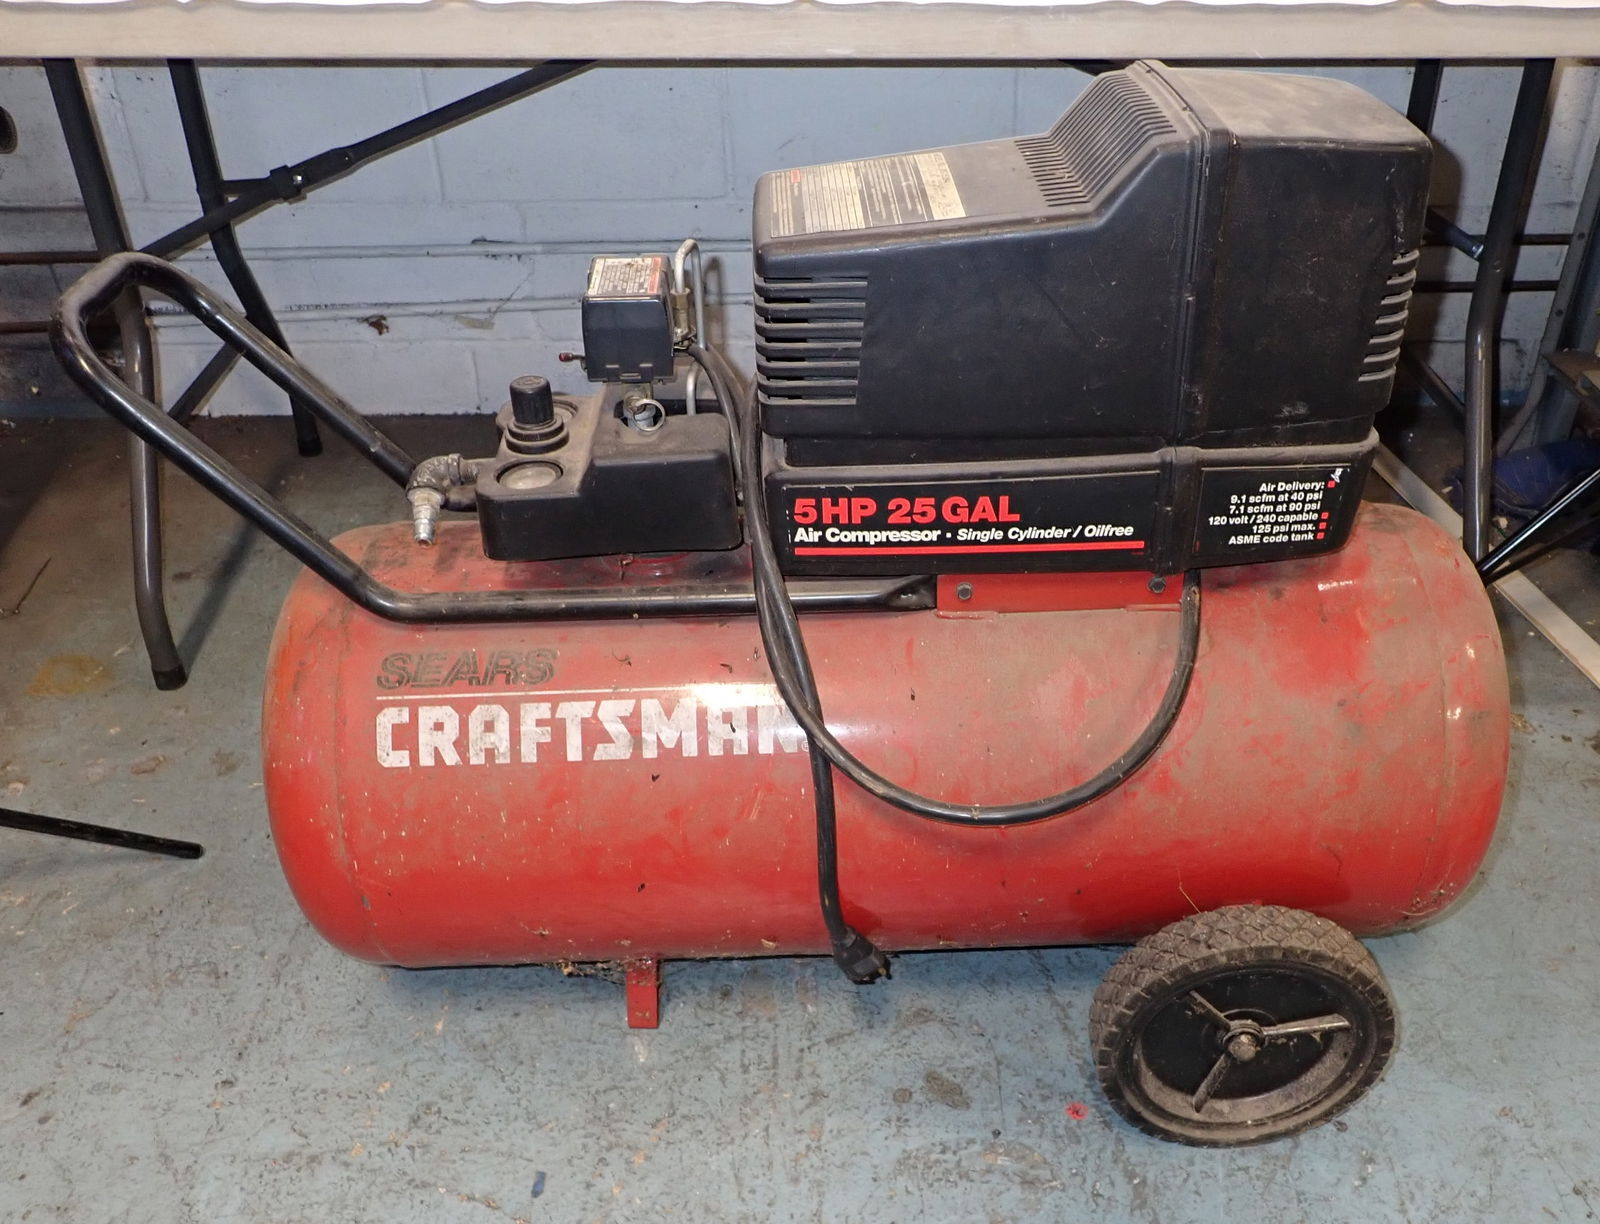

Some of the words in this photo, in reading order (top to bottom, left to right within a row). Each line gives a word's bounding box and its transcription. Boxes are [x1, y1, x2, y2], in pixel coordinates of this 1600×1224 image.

[1259, 482, 1276, 492] Air
[1277, 480, 1325, 492] Delivery:
[1230, 494, 1246, 504] 9.1
[1248, 493, 1276, 503] scfm
[1278, 492, 1289, 502] at
[1291, 492, 1305, 501] 40
[1306, 490, 1323, 502] psi
[1229, 505, 1245, 514] 7.1
[1247, 504, 1274, 514] scfm
[1276, 503, 1287, 512] at
[1289, 502, 1303, 512] 90
[1304, 501, 1321, 512] psi
[1208, 516, 1227, 525] 120
[1229, 515, 1248, 525] volt
[1256, 514, 1276, 523] 240
[1277, 511, 1319, 523] capable
[794, 527, 822, 543] Air
[825, 526, 941, 545] Compressor
[957, 527, 1003, 542] Single
[1084, 524, 1134, 538] Oilfree
[1252, 524, 1272, 534] 125
[1272, 523, 1289, 535] psi
[1291, 522, 1316, 532] max.
[1228, 535, 1261, 545] ASME
[1262, 533, 1289, 543] code
[1291, 532, 1314, 542] tank
[375, 648, 558, 690] SEARS
[375, 698, 799, 768] CRAFTSMAN
